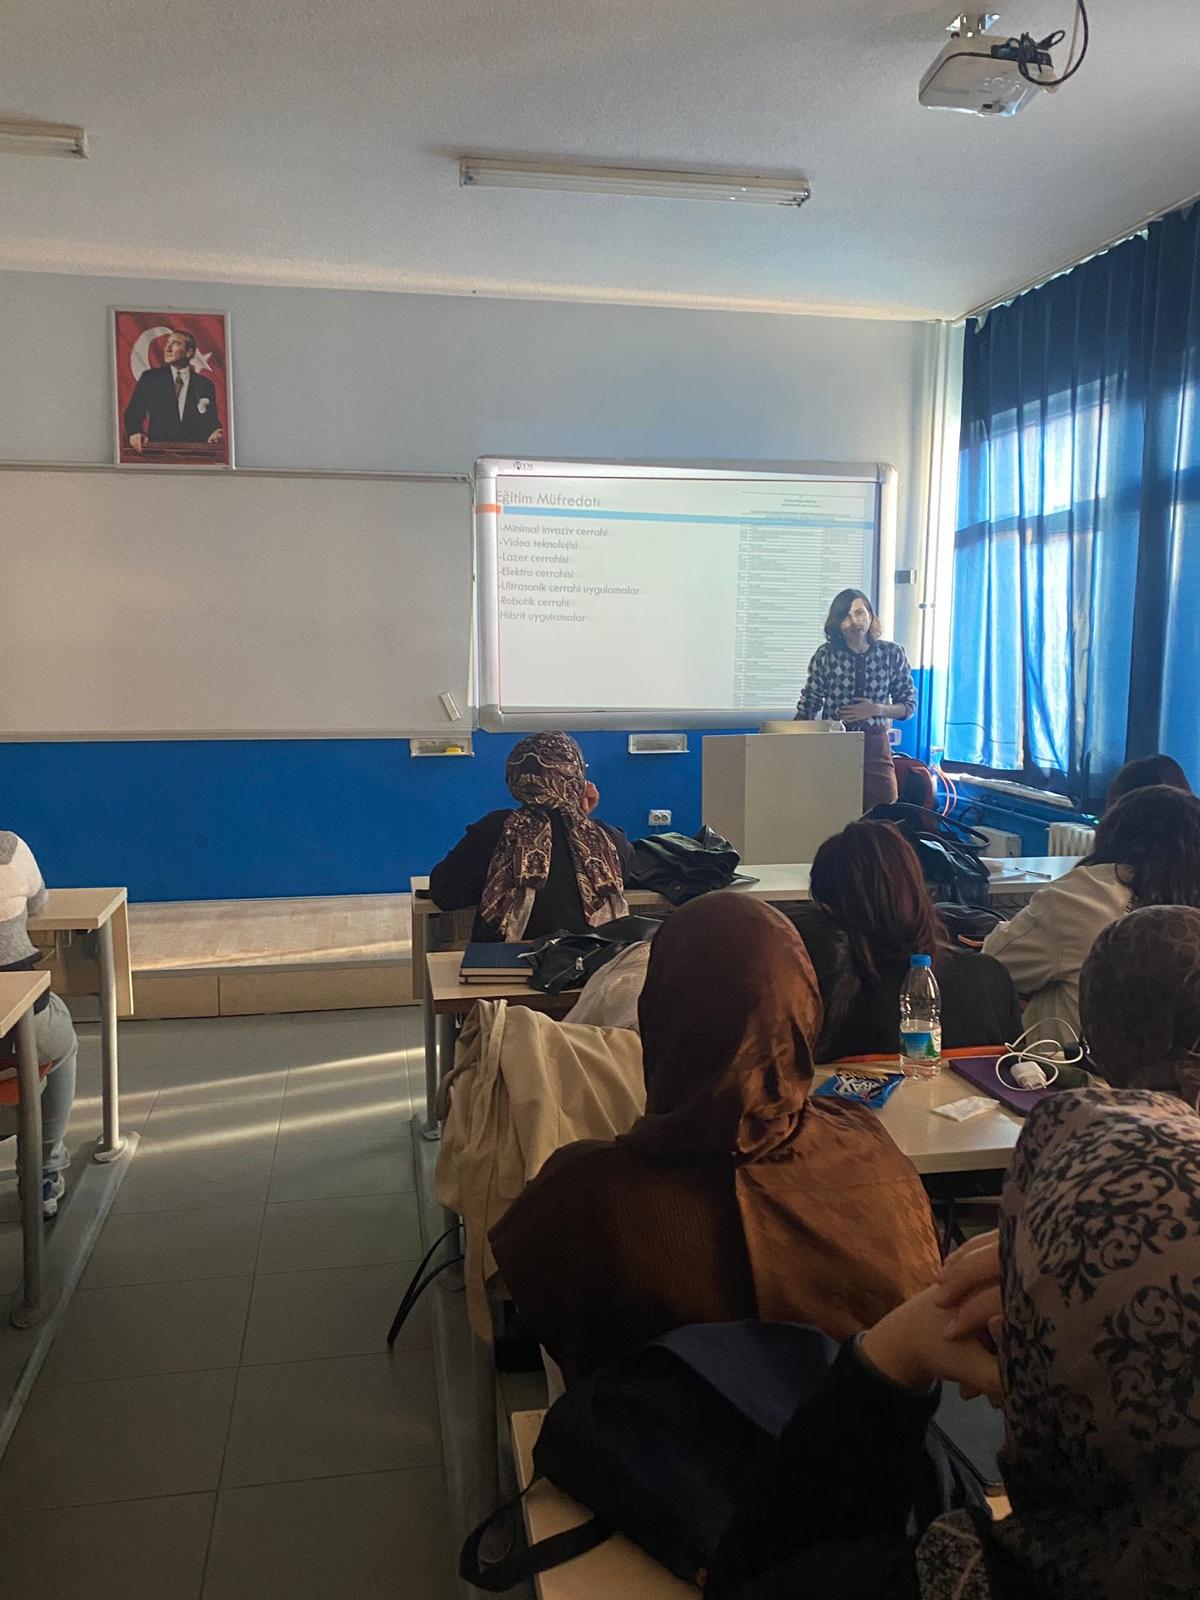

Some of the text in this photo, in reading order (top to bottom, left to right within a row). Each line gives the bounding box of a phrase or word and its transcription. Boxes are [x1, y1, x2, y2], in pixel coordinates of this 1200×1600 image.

[497, 490, 600, 508] Eğitim Müfredatı
[542, 525, 573, 535] invaziv
[577, 527, 608, 537] cerrahi
[533, 540, 578, 551] teknolojisi
[531, 554, 569, 564] cerrahisi
[536, 569, 574, 579] cerrahisi
[549, 584, 581, 594] cerrahi
[583, 586, 640, 597] uygulamalar
[537, 598, 570, 607] cerrahi
[528, 613, 586, 624] uygulamalar
